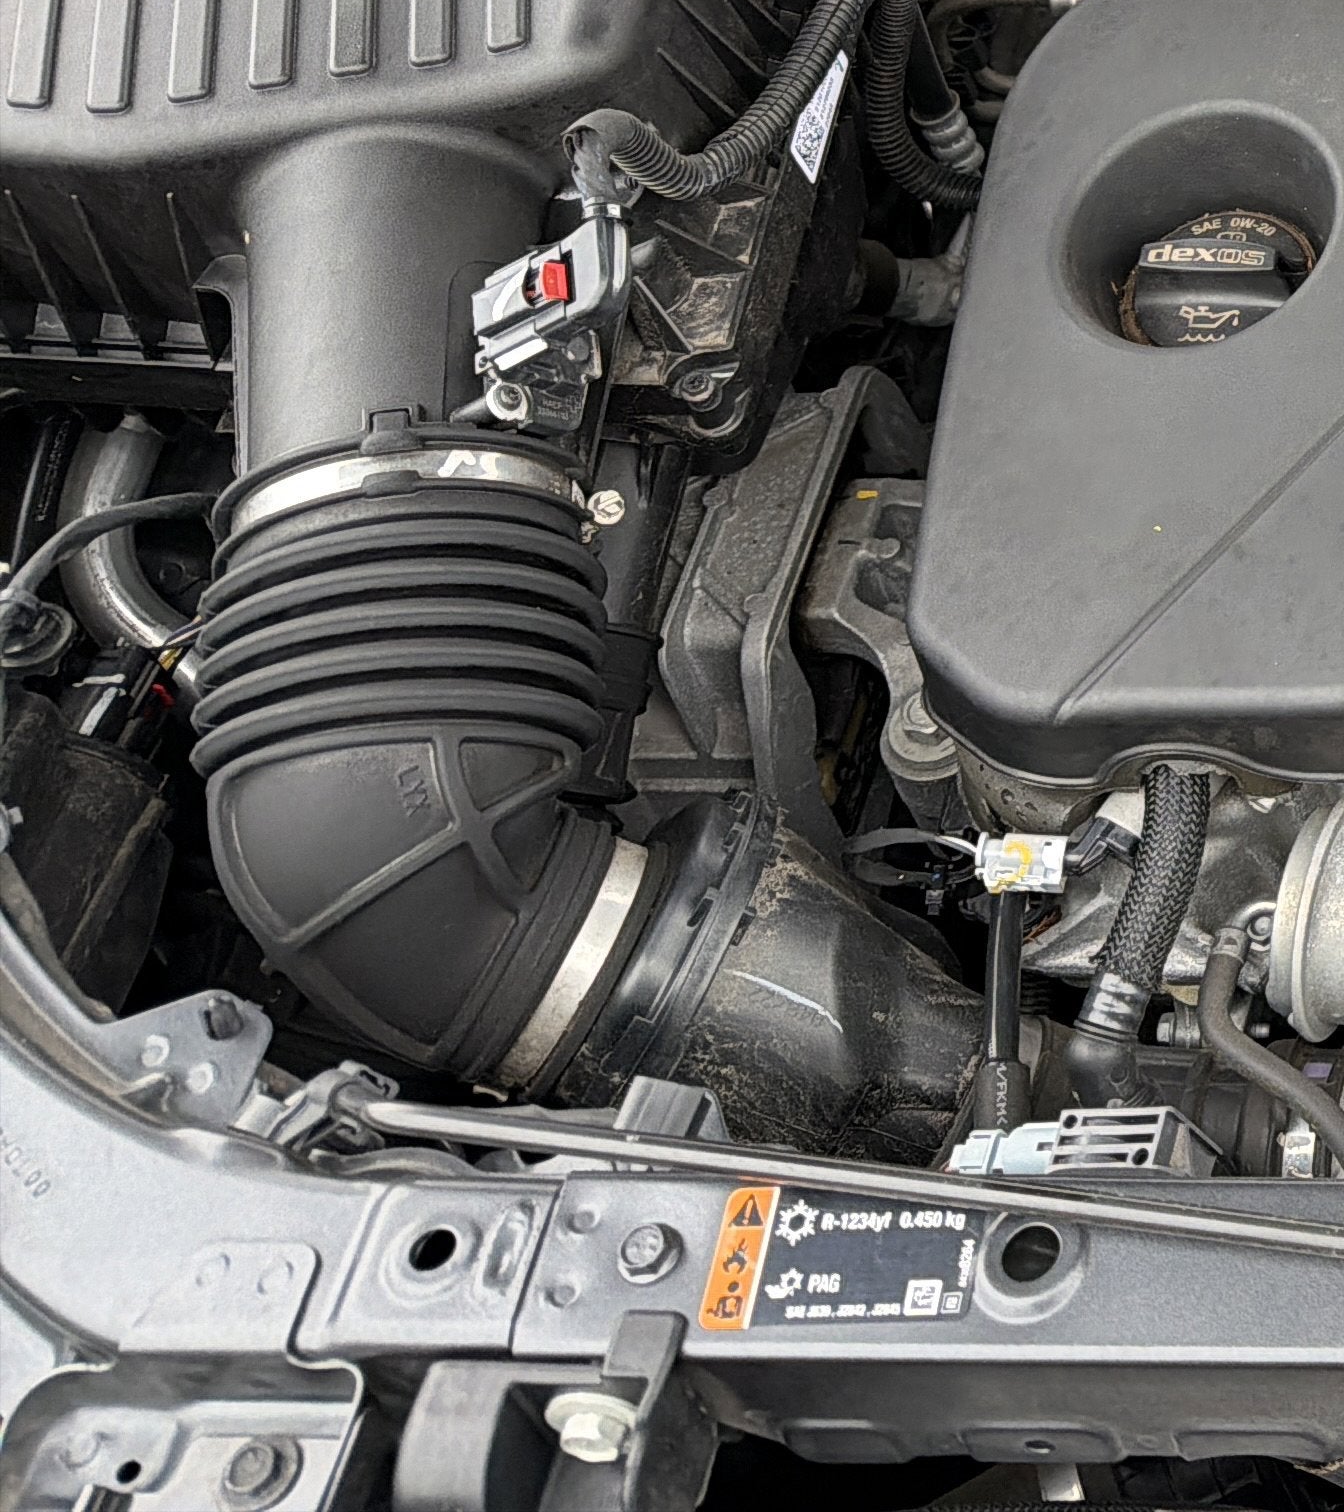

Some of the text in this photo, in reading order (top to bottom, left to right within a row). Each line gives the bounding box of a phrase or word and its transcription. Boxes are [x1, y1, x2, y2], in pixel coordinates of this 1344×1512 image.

[1190, 217, 1277, 237] SAE 0W-20
[1147, 244, 1266, 266] dexos
[821, 1211, 966, 1232] R-1234yf 0.450 kg
[807, 1273, 840, 1293] PAG
